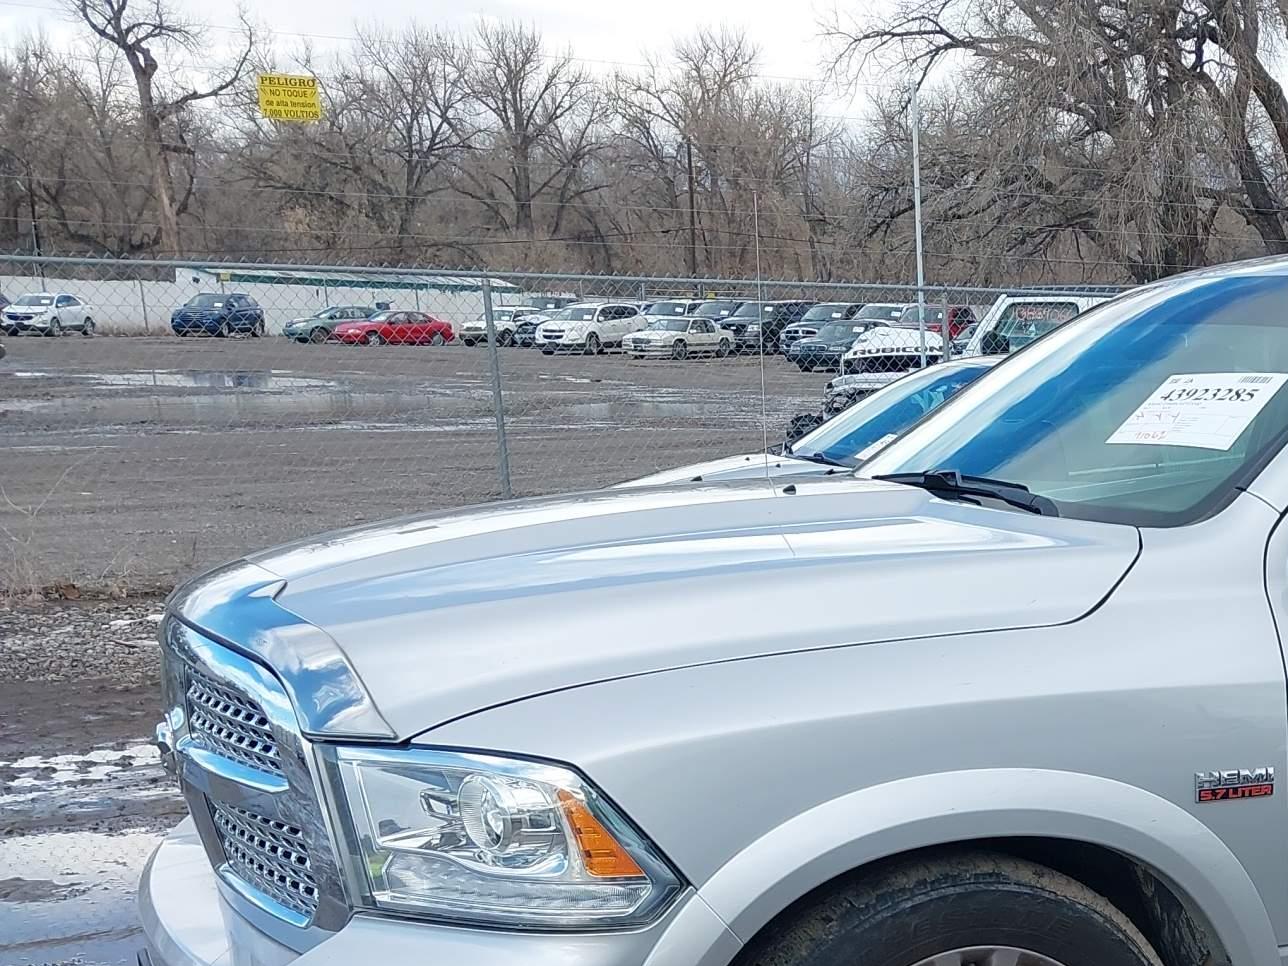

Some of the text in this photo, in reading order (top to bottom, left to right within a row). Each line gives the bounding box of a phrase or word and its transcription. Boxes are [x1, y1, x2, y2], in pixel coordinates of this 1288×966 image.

[260, 76, 316, 87] PELIGRO
[269, 88, 308, 98] NO TOQUE
[265, 99, 275, 107] de
[276, 99, 289, 107] alta
[283, 109, 320, 119] VOLTIOS
[852, 345, 944, 357] RUBICON
[1160, 387, 1260, 402] 43923285
[1195, 767, 1275, 788] HEMI
[1199, 784, 1274, 802] 5.7 LITER
